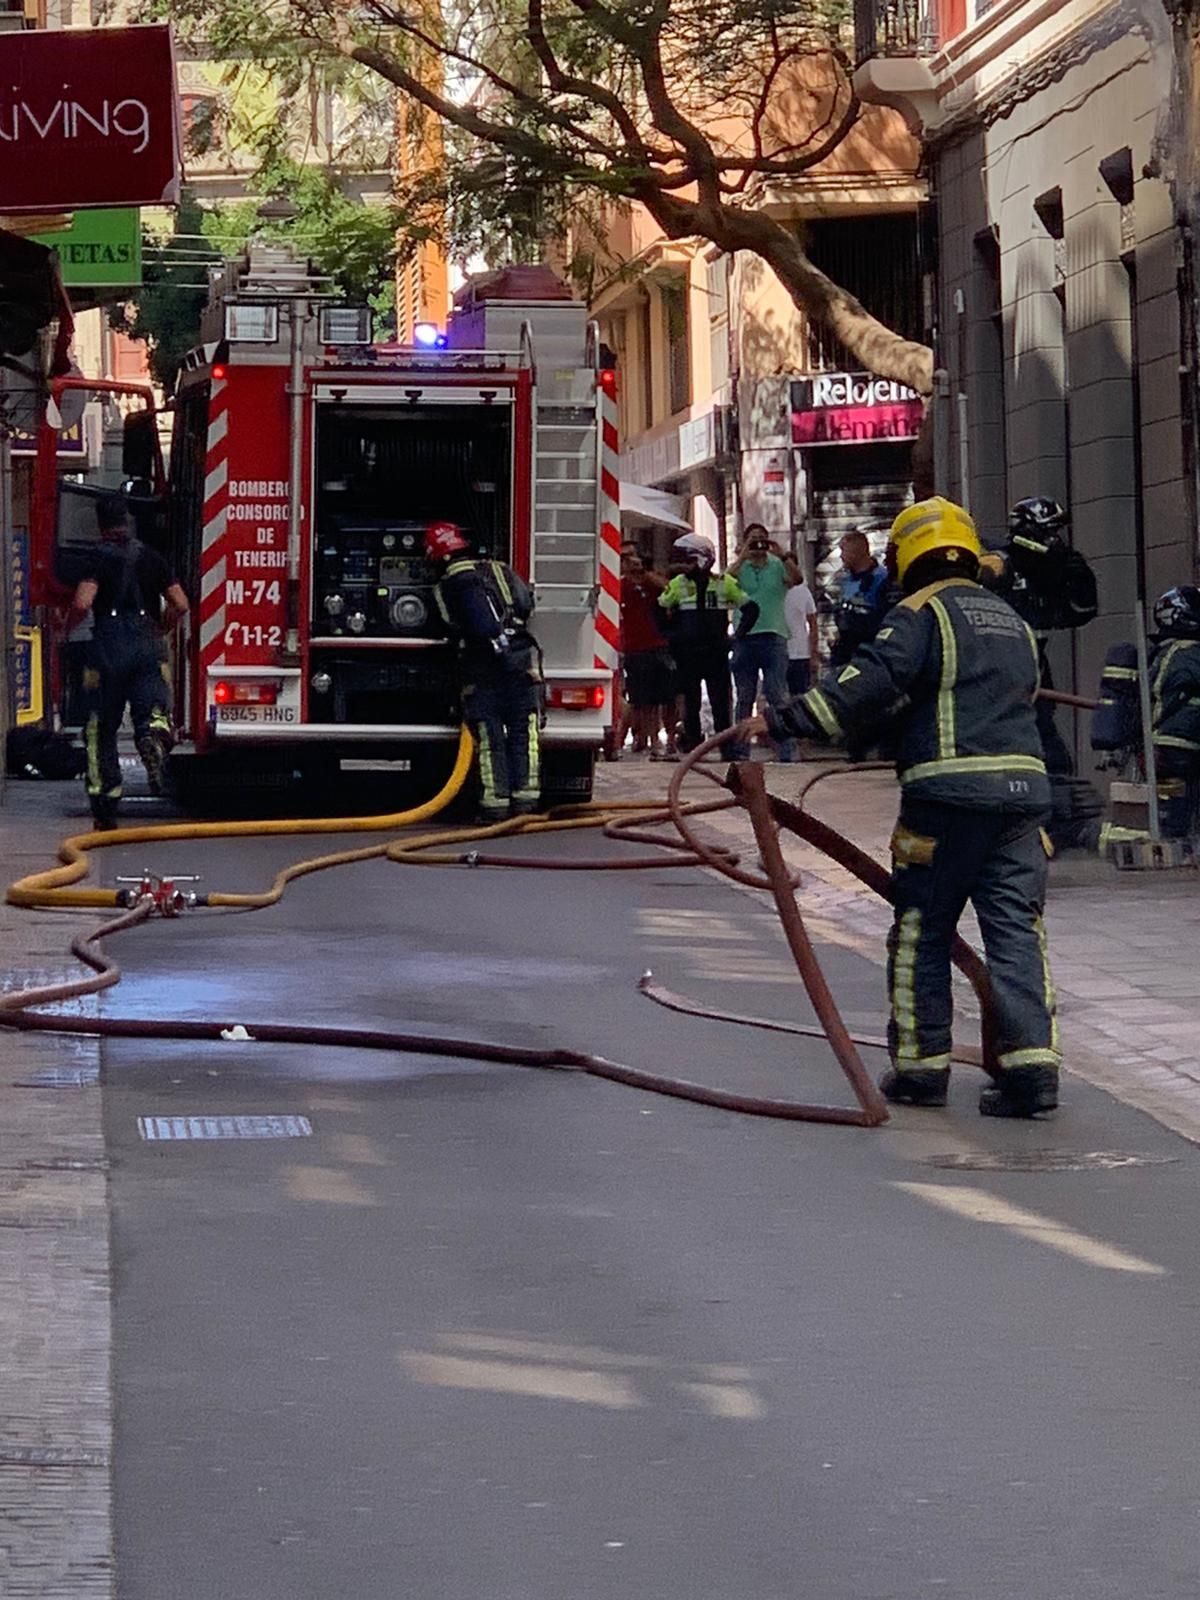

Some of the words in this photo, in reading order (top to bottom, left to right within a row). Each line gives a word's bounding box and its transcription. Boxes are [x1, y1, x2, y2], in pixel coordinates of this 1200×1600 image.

[228, 480, 290, 498] BOMBER
[256, 527, 274, 545] DE
[235, 550, 290, 568] TENERIF
[225, 579, 281, 605] M-74
[241, 625, 282, 647] 1-1-2
[263, 707, 294, 722] HNG
